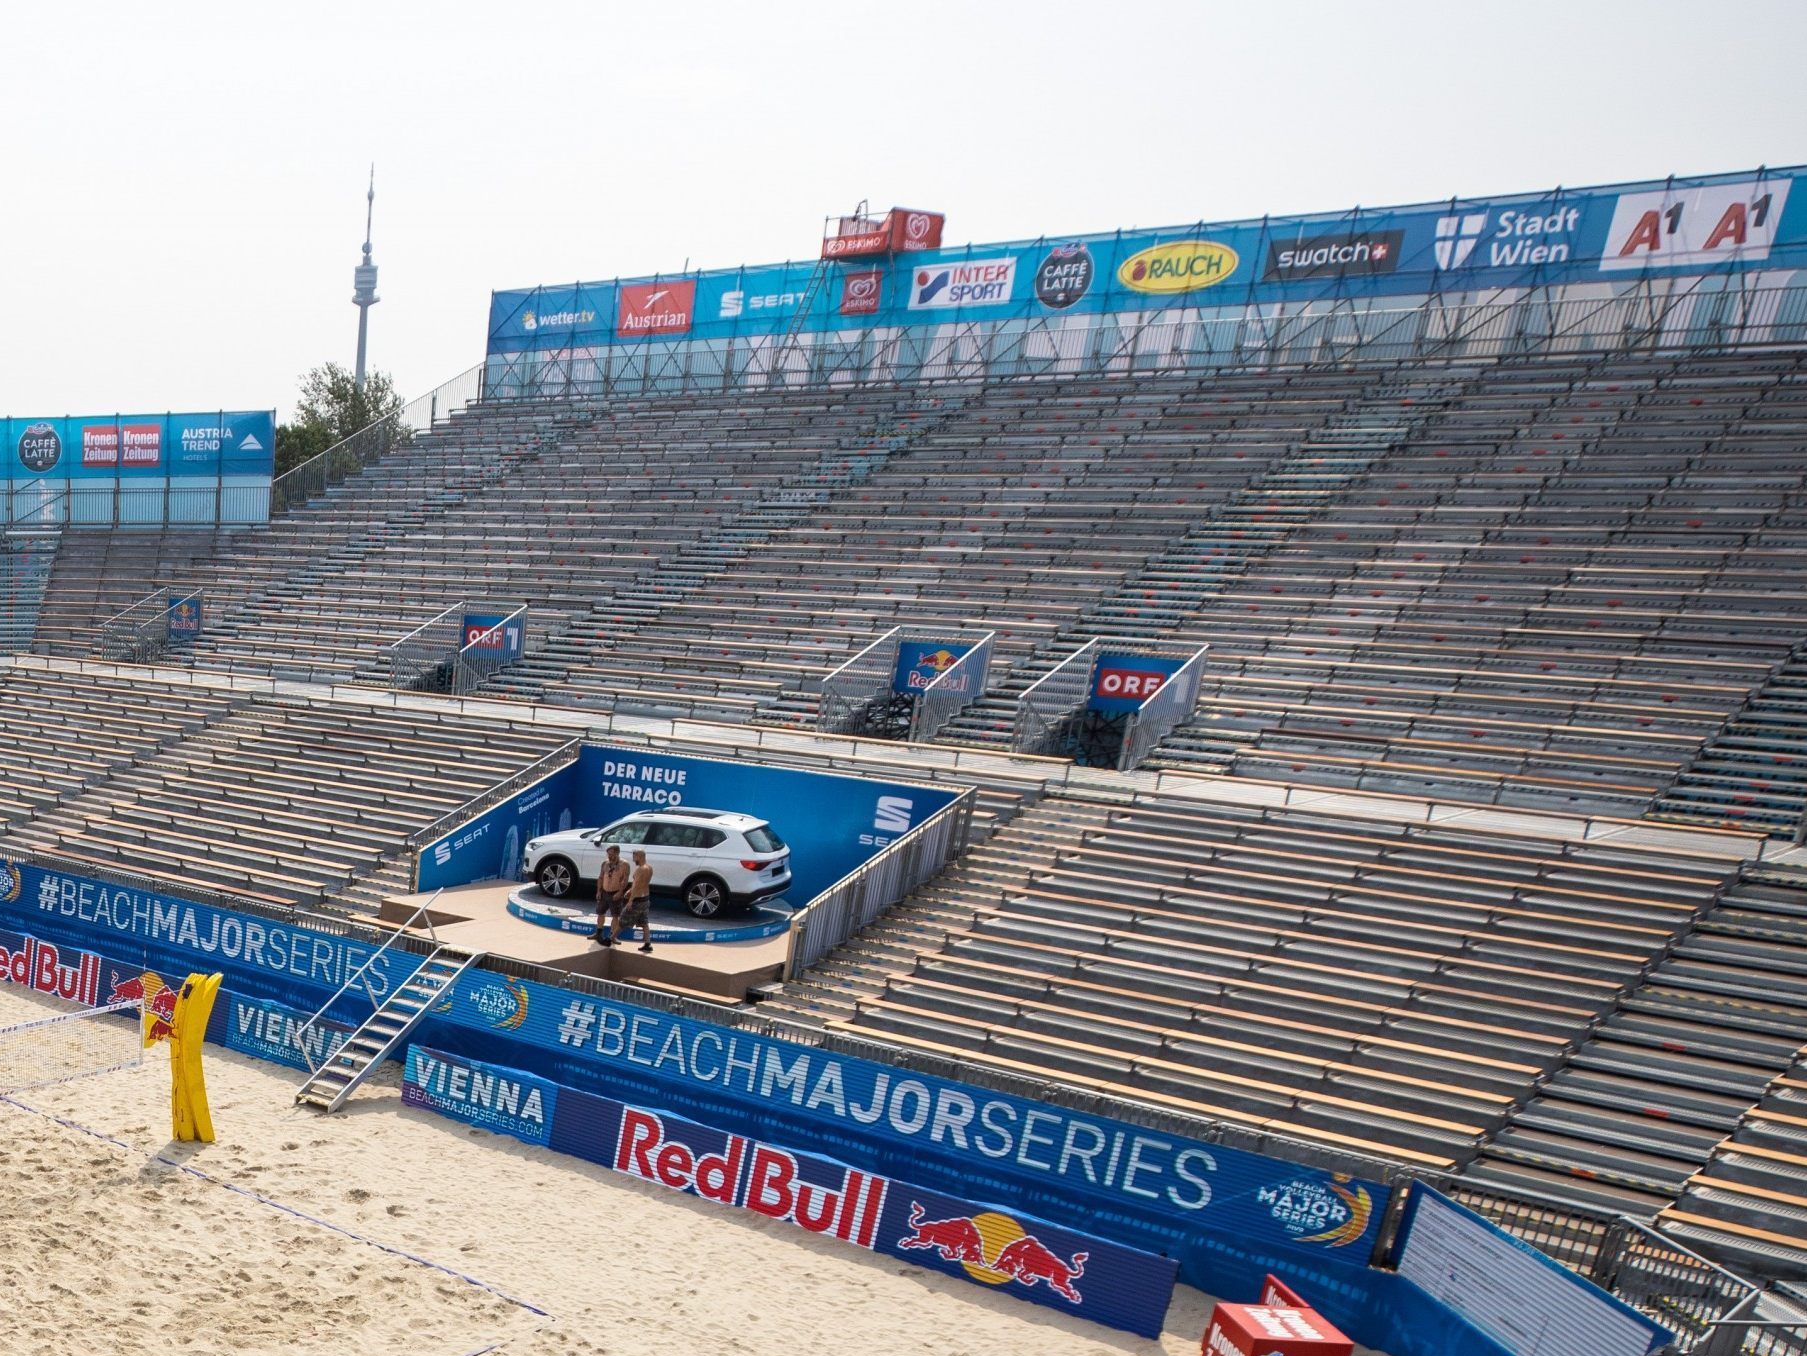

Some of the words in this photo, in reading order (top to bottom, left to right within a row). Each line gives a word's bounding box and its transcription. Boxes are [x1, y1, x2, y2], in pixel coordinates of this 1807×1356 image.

[1497, 206, 1579, 239] Stadt
[1620, 201, 1685, 256] A1
[1703, 194, 1772, 250] A1
[848, 237, 880, 249] ESKIMO
[1491, 241, 1569, 267] Wien
[1148, 253, 1222, 279] RAUCH
[1277, 242, 1370, 268] swatch
[952, 264, 1008, 284] INTER
[1044, 276, 1084, 290] LATTE
[750, 291, 806, 307] SEAT
[949, 282, 1006, 301] SPORT
[846, 299, 875, 308] ESKIMO
[540, 309, 594, 326] wetter.tv
[624, 310, 686, 330] Austrian
[84, 432, 117, 446] Kronen
[123, 430, 159, 445] Kronen
[181, 428, 233, 439] AUSTRIA
[24, 448, 55, 458] LATTE
[84, 447, 117, 462] Zeitung
[123, 446, 158, 462] Zeitung
[181, 440, 220, 451] TREND
[1102, 674, 1161, 695] ORF
[604, 760, 637, 779] DER
[641, 764, 687, 786] NEUE
[518, 793, 550, 815] Barcelona
[602, 782, 682, 805] TARRACO
[454, 823, 491, 850] SEAT
[38, 873, 390, 998] #BEACHMAJORSERIES
[470, 990, 517, 1012] MAJOR
[478, 1004, 507, 1018] SERIES
[237, 1003, 343, 1058] VIENNA
[415, 1054, 544, 1124] VIENNA
[409, 1087, 543, 1139] BEACHMAJORSERIES.COM
[557, 998, 1219, 1211] #BEACHMAJORSERIES
[1279, 1184, 1339, 1206] VOLLEYBALL
[1291, 1180, 1326, 1194] BEACH
[1257, 1186, 1347, 1222] MAJOR
[1271, 1206, 1326, 1229] SERIES
